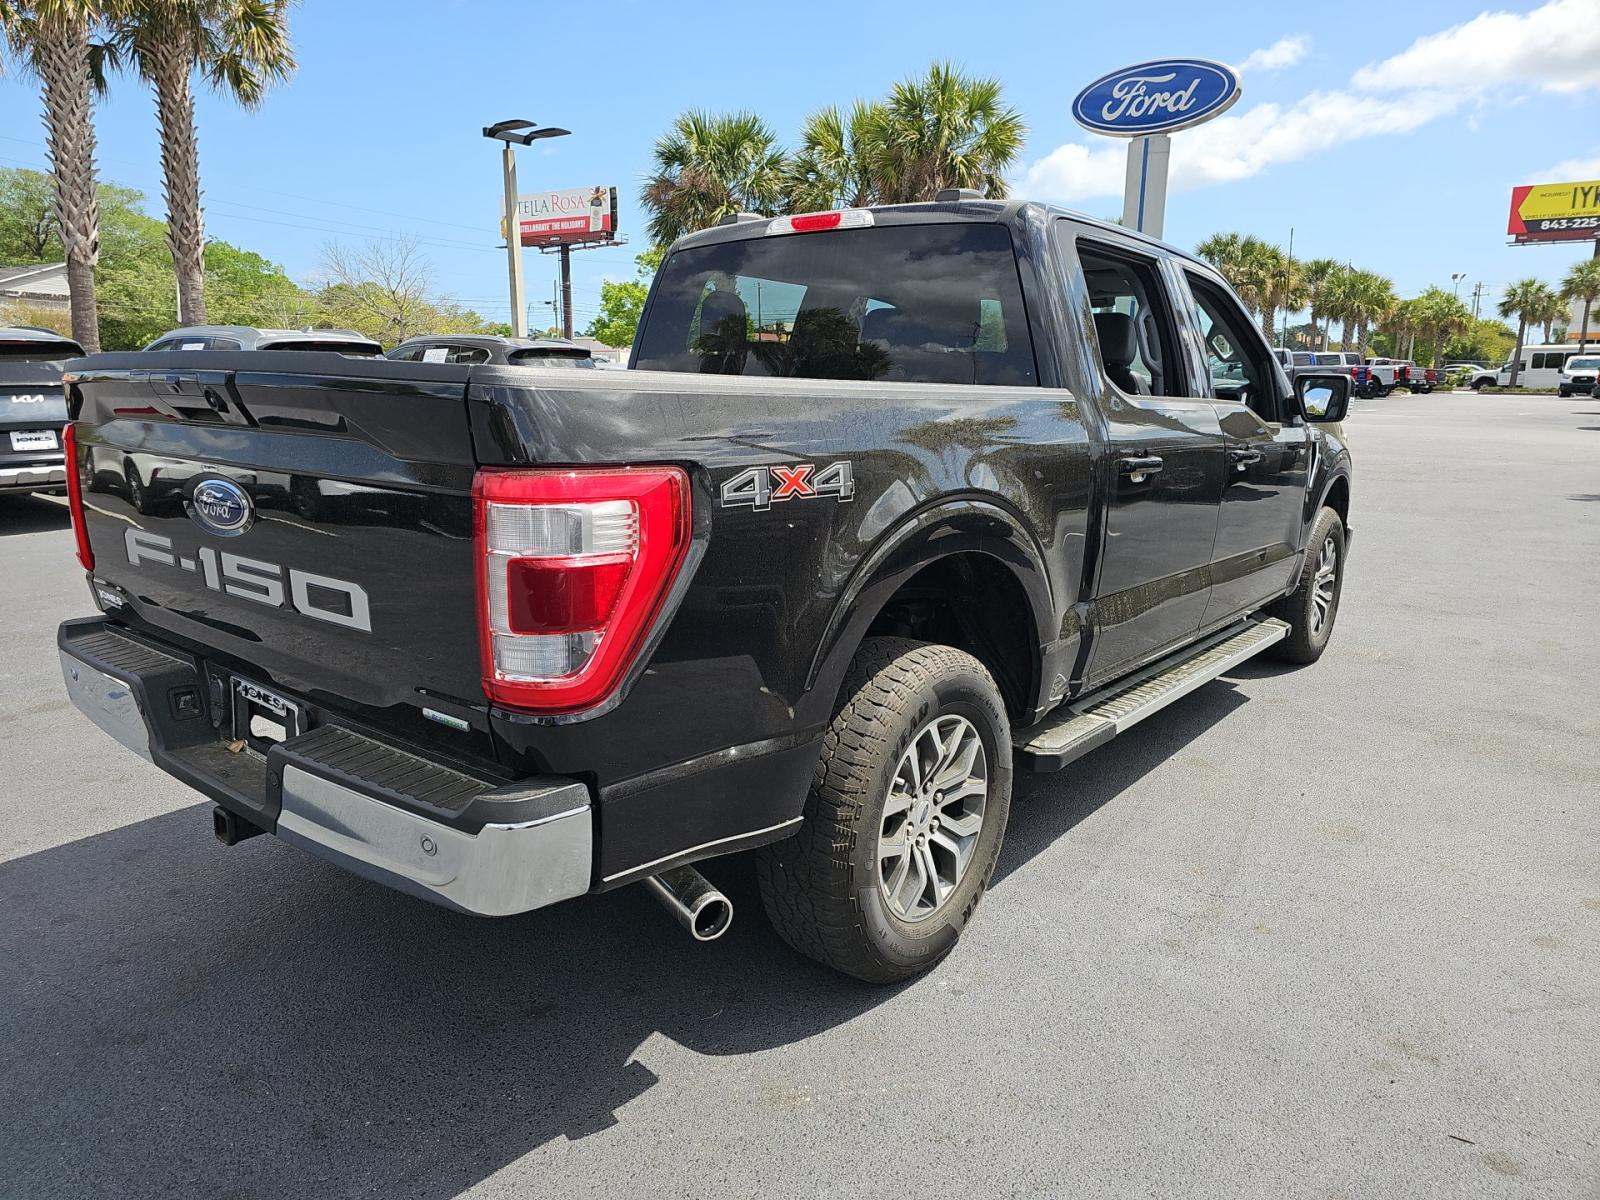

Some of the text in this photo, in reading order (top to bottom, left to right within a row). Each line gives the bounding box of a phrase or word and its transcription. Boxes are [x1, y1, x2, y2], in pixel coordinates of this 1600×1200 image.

[1101, 72, 1202, 121] Ford
[518, 199, 550, 217] TELLA
[199, 489, 233, 520] Ford
[124, 527, 372, 633] F-150
